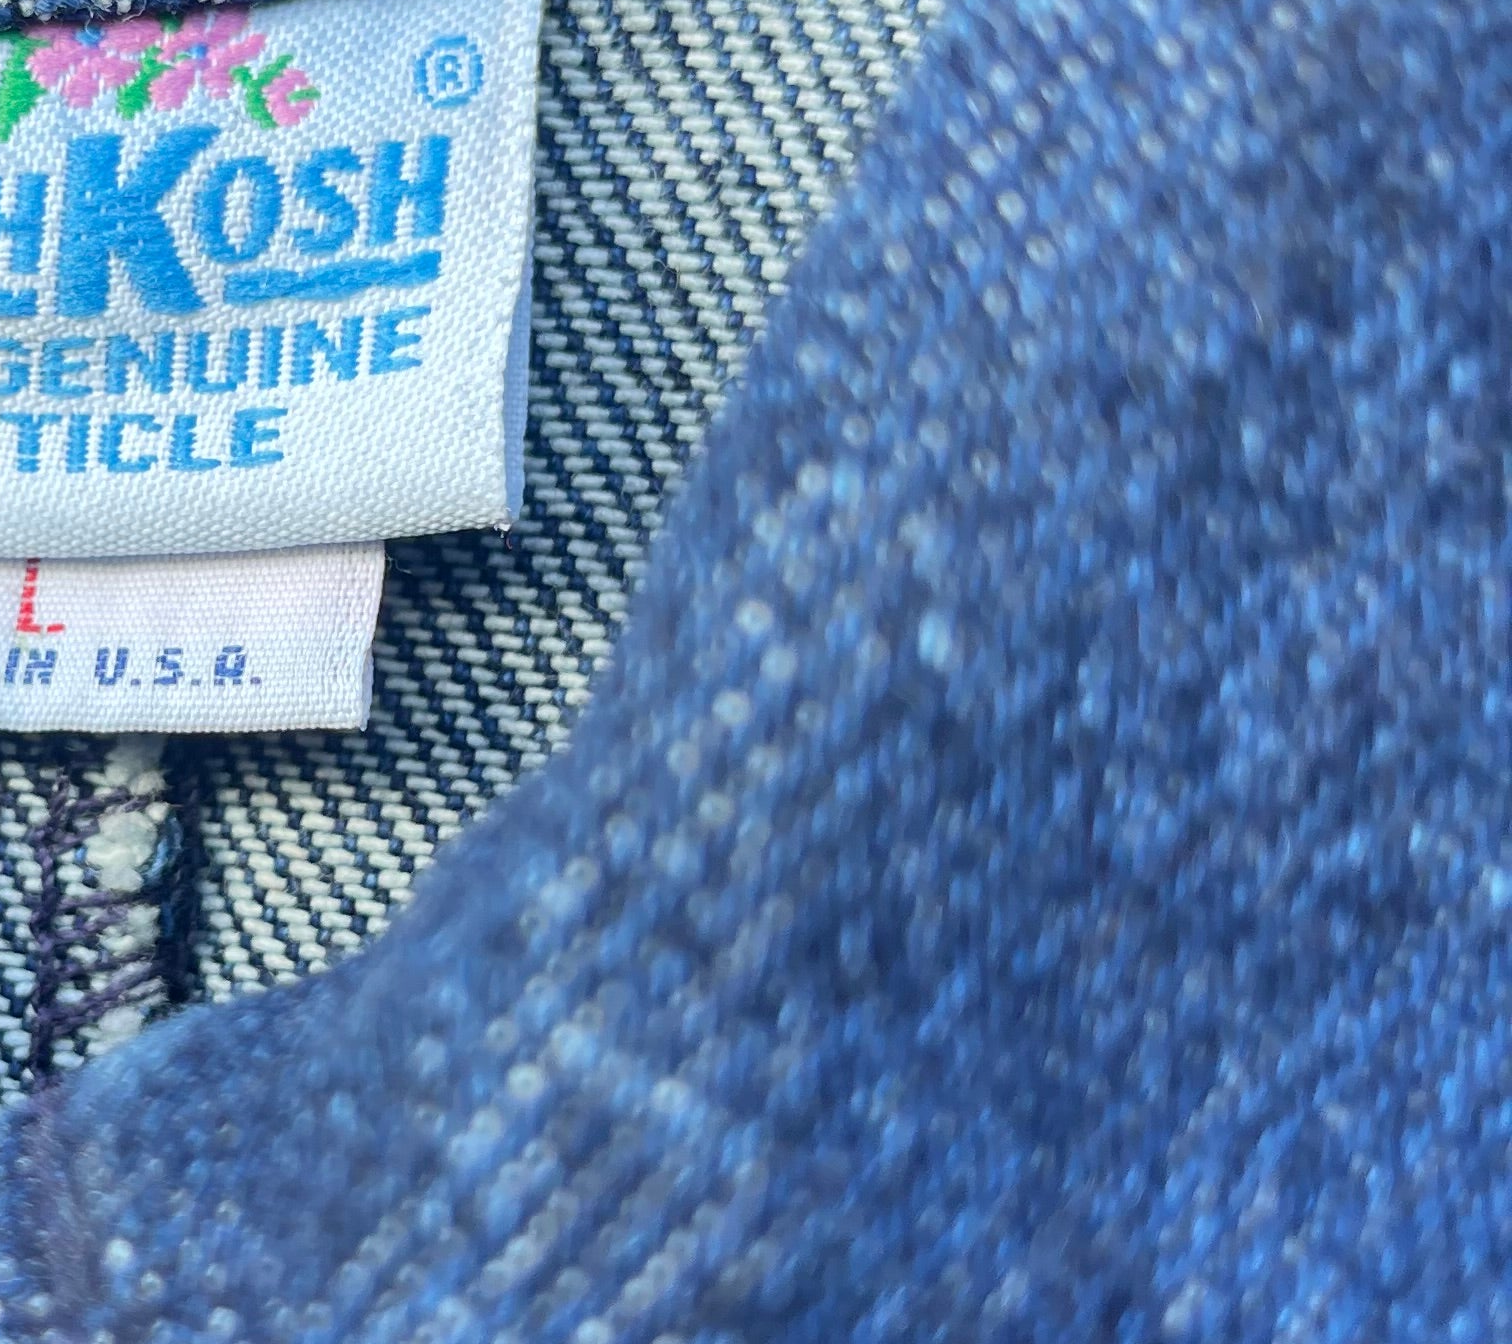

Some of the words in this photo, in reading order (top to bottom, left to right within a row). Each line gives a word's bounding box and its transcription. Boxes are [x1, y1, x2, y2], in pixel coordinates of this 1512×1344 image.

[16, 558, 65, 634] L
[4, 646, 60, 687] IN
[94, 643, 262, 687] U.S.A.
